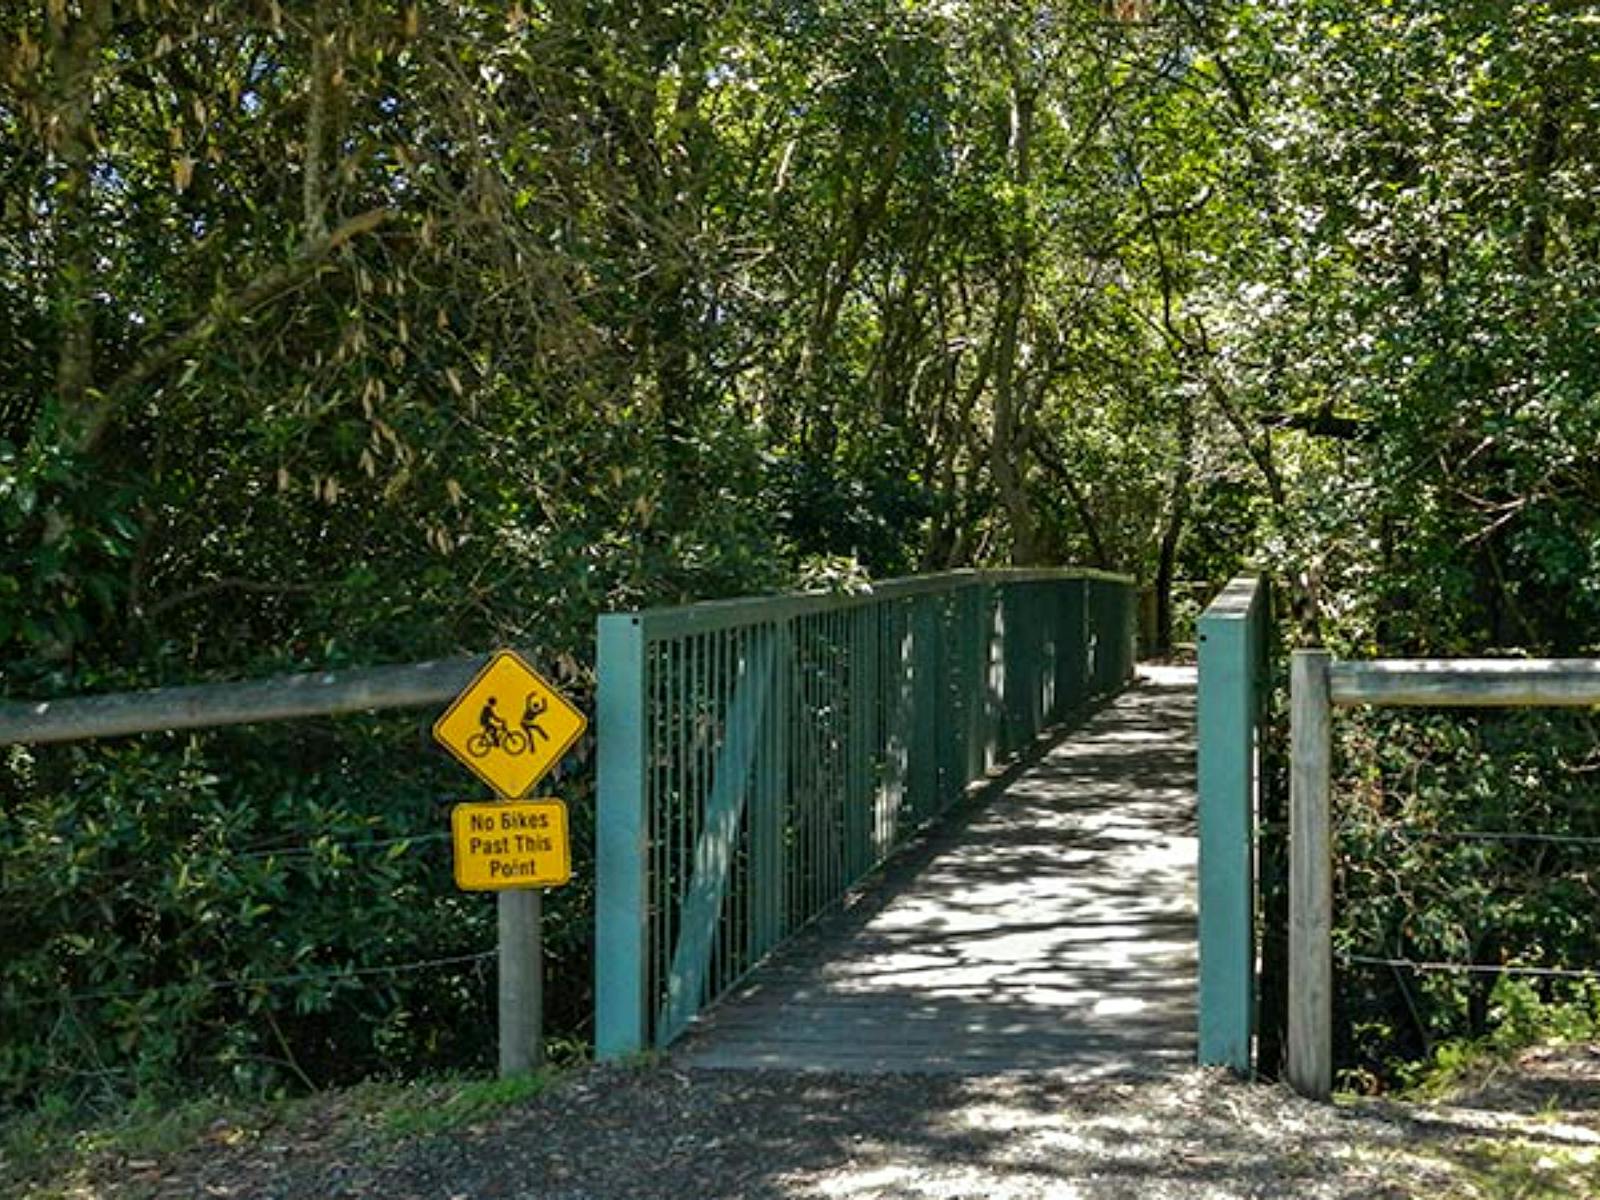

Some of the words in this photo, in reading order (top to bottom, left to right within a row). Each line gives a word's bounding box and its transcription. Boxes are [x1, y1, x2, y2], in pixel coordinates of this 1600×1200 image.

[471, 814, 494, 831] No
[501, 812, 549, 830] Bikes
[469, 836, 509, 854] Past
[514, 834, 552, 852] This
[489, 859, 535, 877] Point
